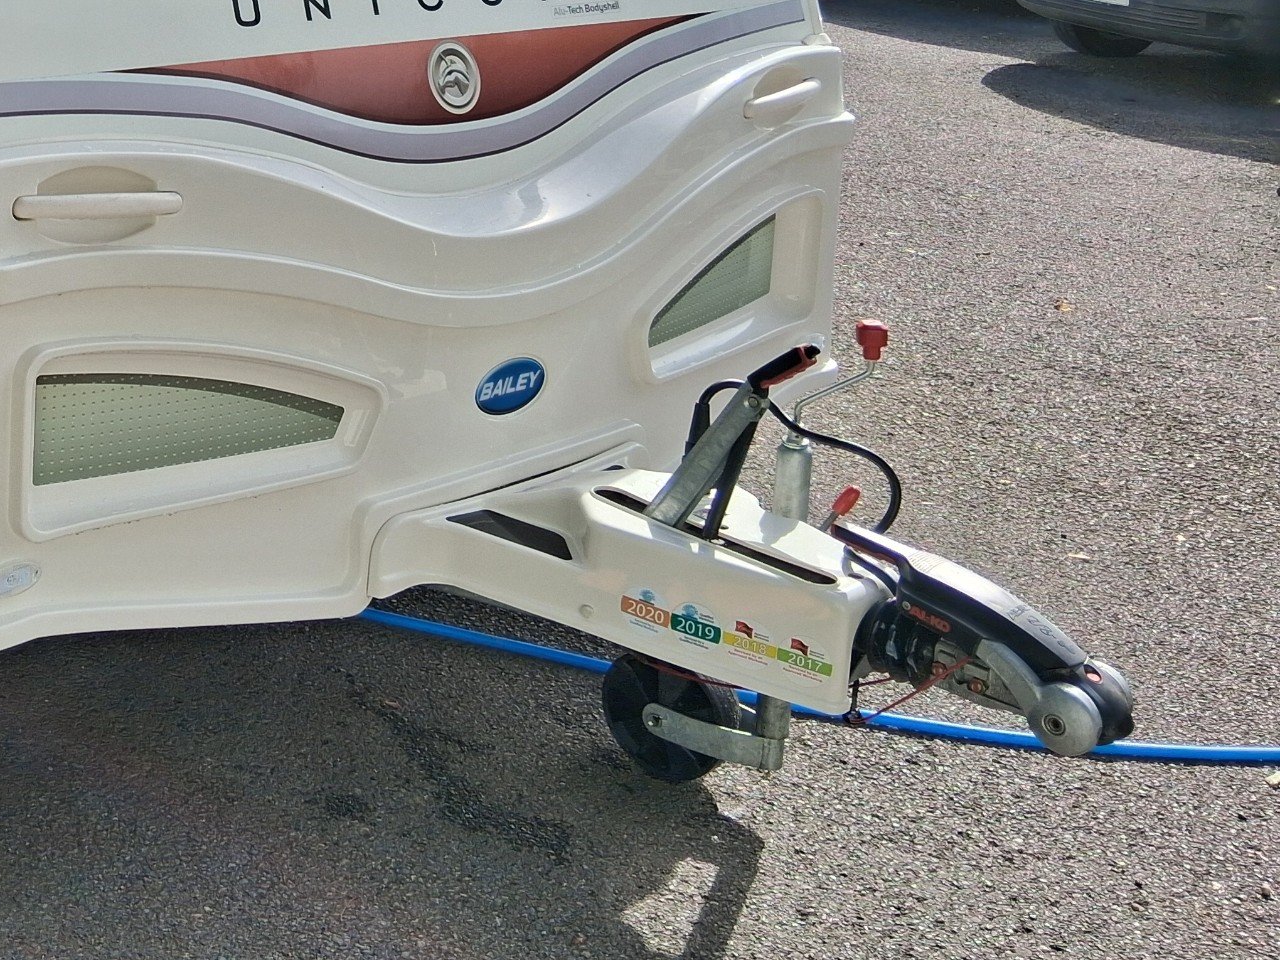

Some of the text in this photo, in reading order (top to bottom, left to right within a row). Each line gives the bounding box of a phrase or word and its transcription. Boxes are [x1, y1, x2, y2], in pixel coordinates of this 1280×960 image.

[584, 0, 620, 14] Bodyshell
[479, 369, 541, 402] BAILEY
[627, 600, 665, 624] 2020
[676, 617, 715, 640] 2019
[733, 636, 767, 655] 2018
[788, 653, 823, 672] 2017
